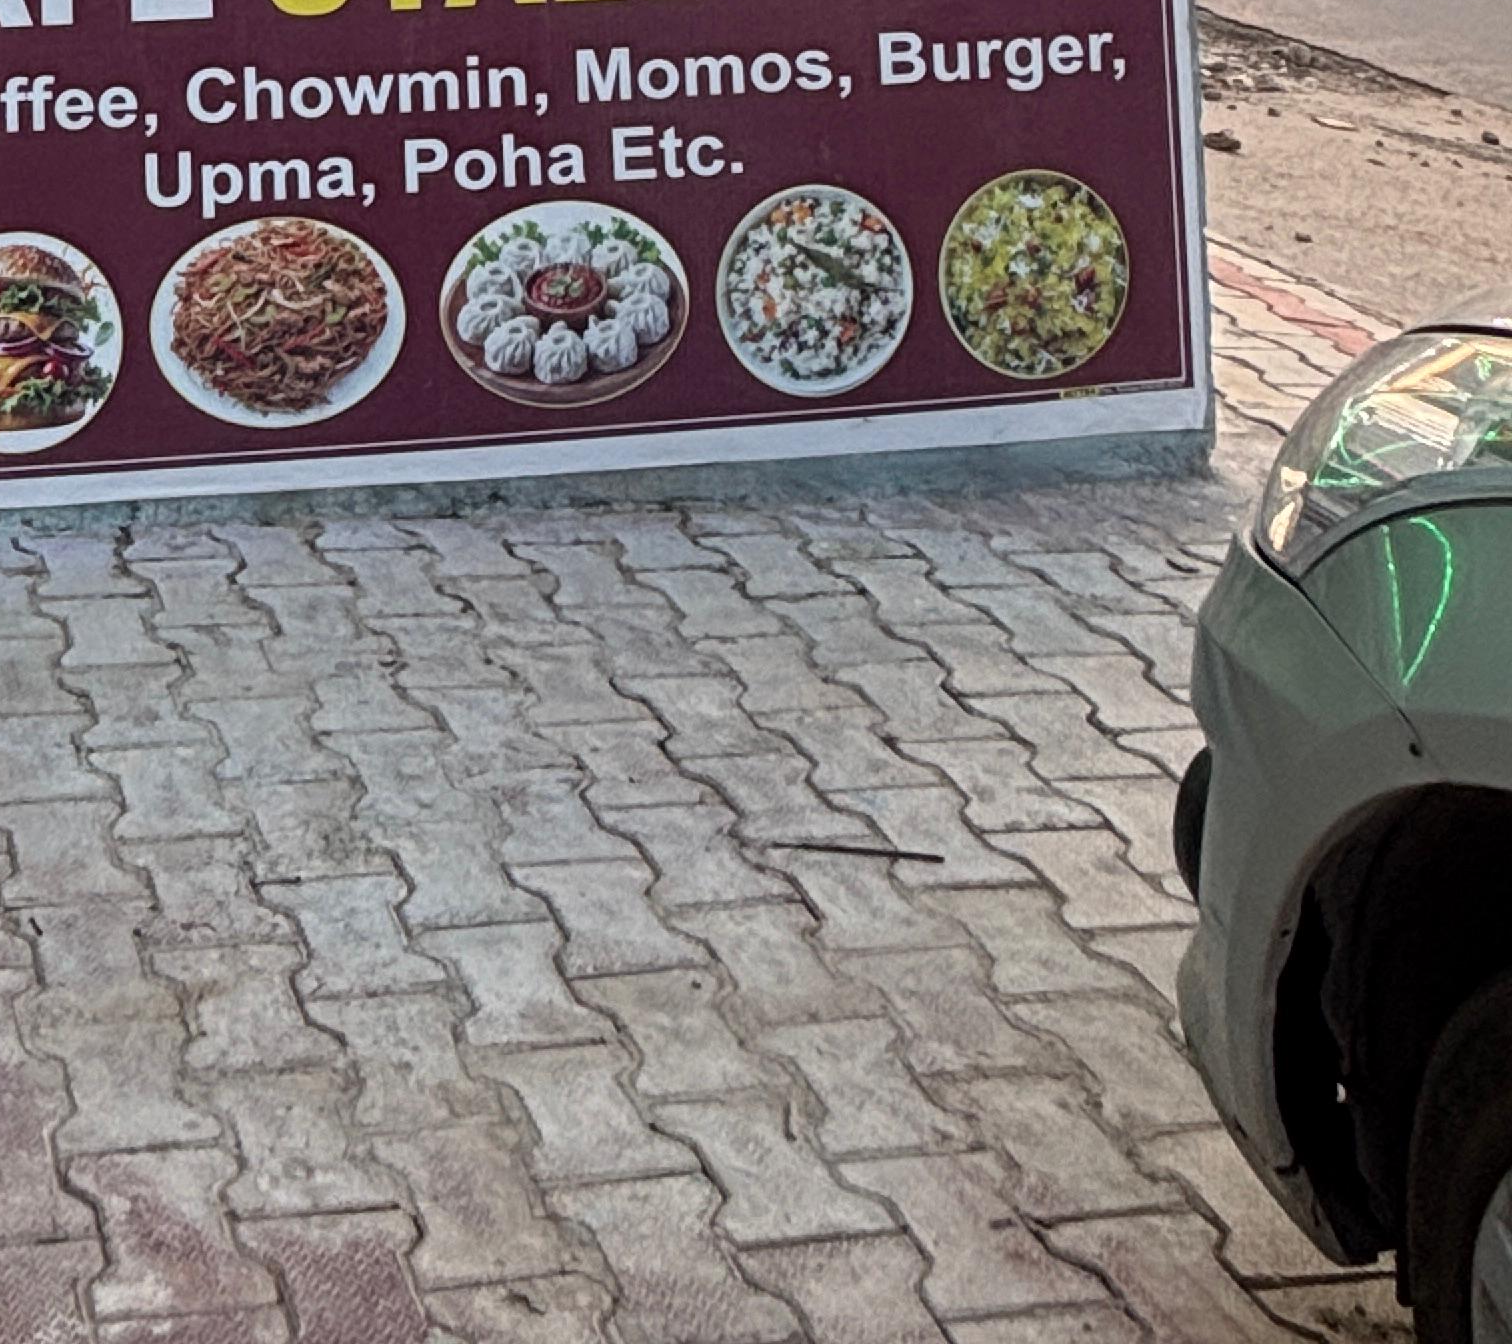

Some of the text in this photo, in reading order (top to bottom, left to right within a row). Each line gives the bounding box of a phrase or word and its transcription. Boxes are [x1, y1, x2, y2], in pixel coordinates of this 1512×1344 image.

[186, 55, 549, 124] Chowmin,
[576, 46, 853, 103] Momos,
[878, 30, 1127, 93] Burger,
[144, 126, 745, 220] Upma, Poha Etc.
